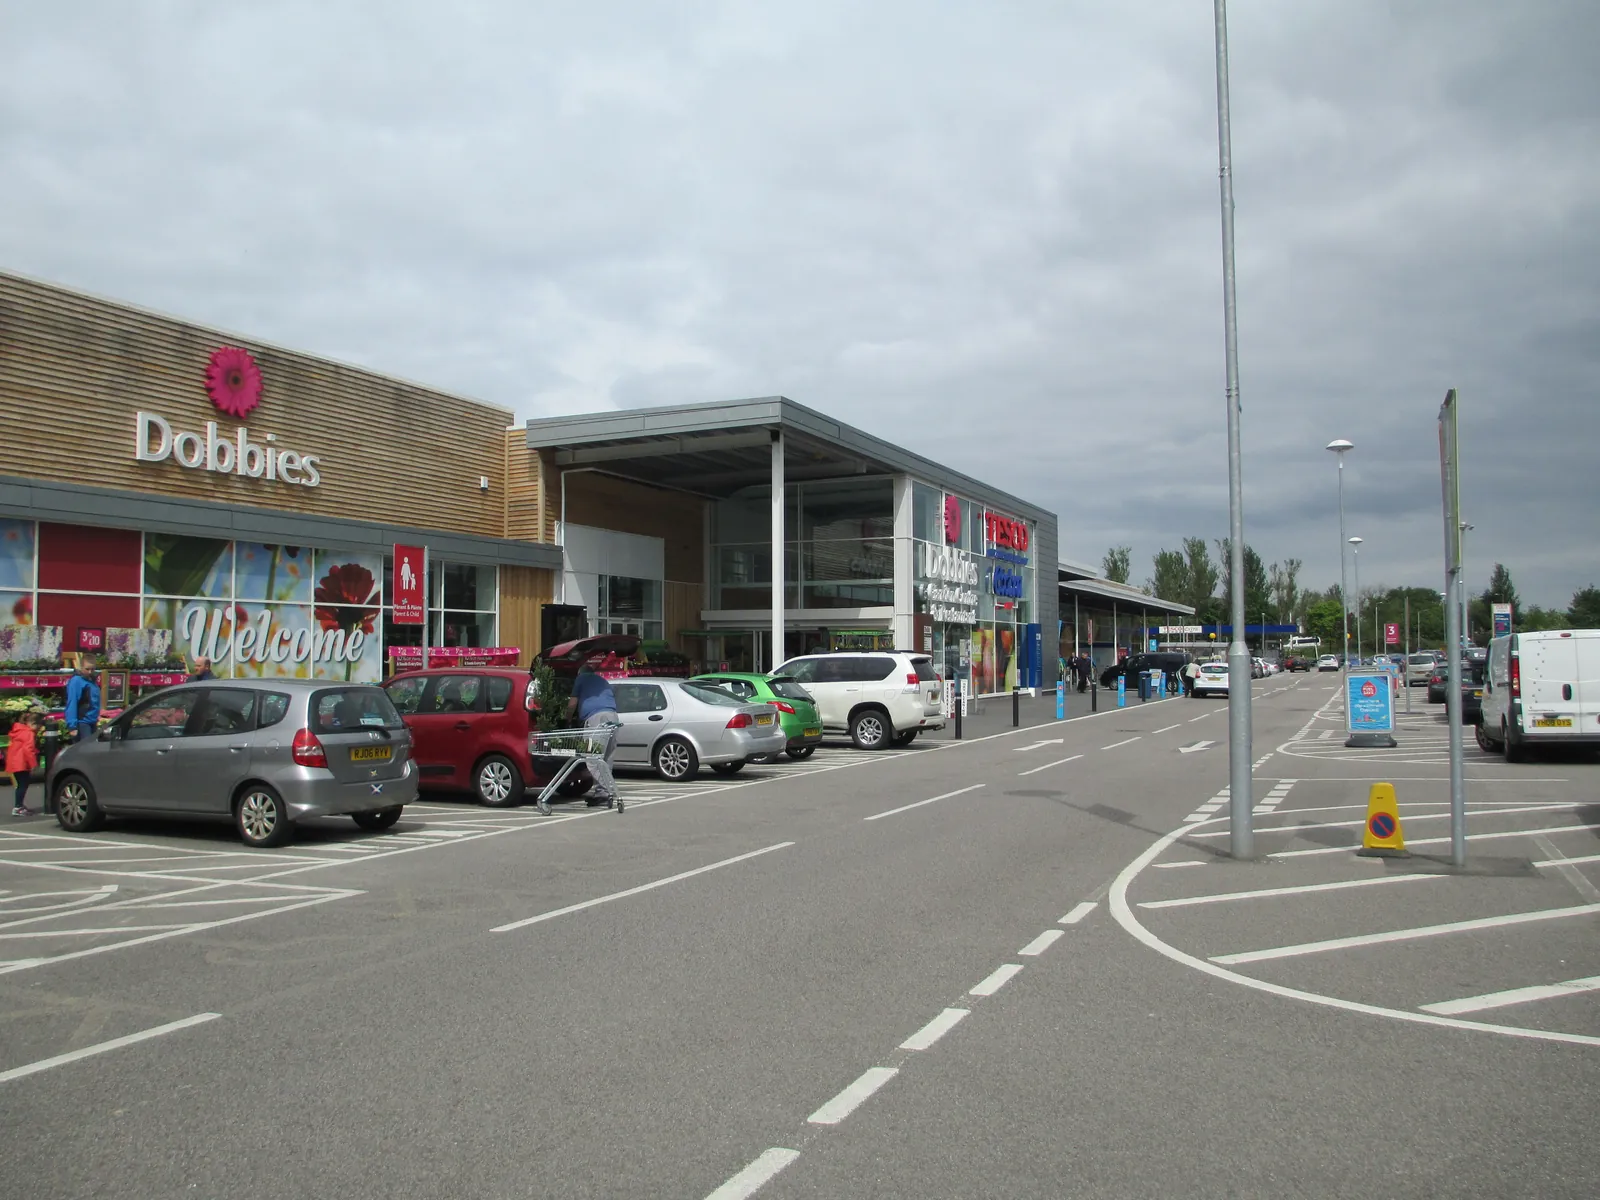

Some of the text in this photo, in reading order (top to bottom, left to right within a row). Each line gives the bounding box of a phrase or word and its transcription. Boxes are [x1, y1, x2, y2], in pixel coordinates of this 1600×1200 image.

[136, 411, 321, 487] Dobbies
[985, 512, 1029, 552] TESCO
[926, 542, 978, 586] Dobbies
[82, 631, 88, 642] 3
[89, 636, 100, 645] £10
[182, 606, 365, 665] Welcome
[1388, 626, 1395, 635] 3
[354, 747, 389, 759] RJ06 RYV
